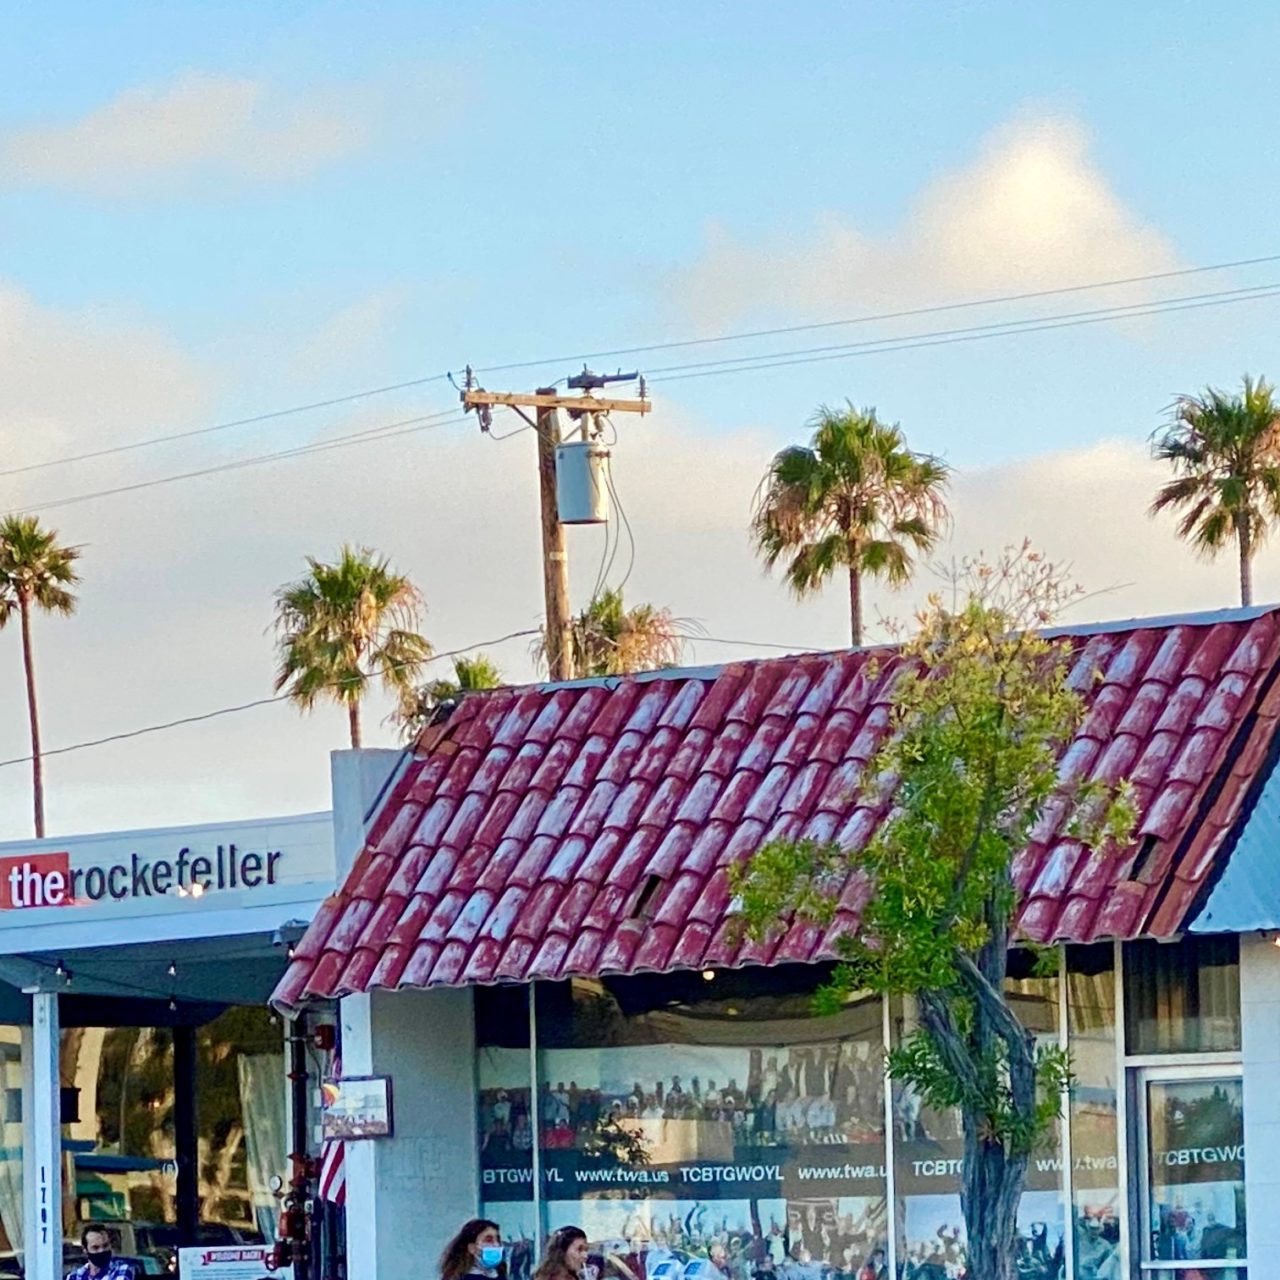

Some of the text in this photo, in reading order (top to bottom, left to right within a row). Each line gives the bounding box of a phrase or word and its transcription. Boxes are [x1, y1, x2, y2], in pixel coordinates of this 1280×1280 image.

[8, 844, 281, 907] the rockefeller
[575, 1166, 670, 1183] www.twa.us
[680, 1165, 785, 1182] TCBTGWOYL
